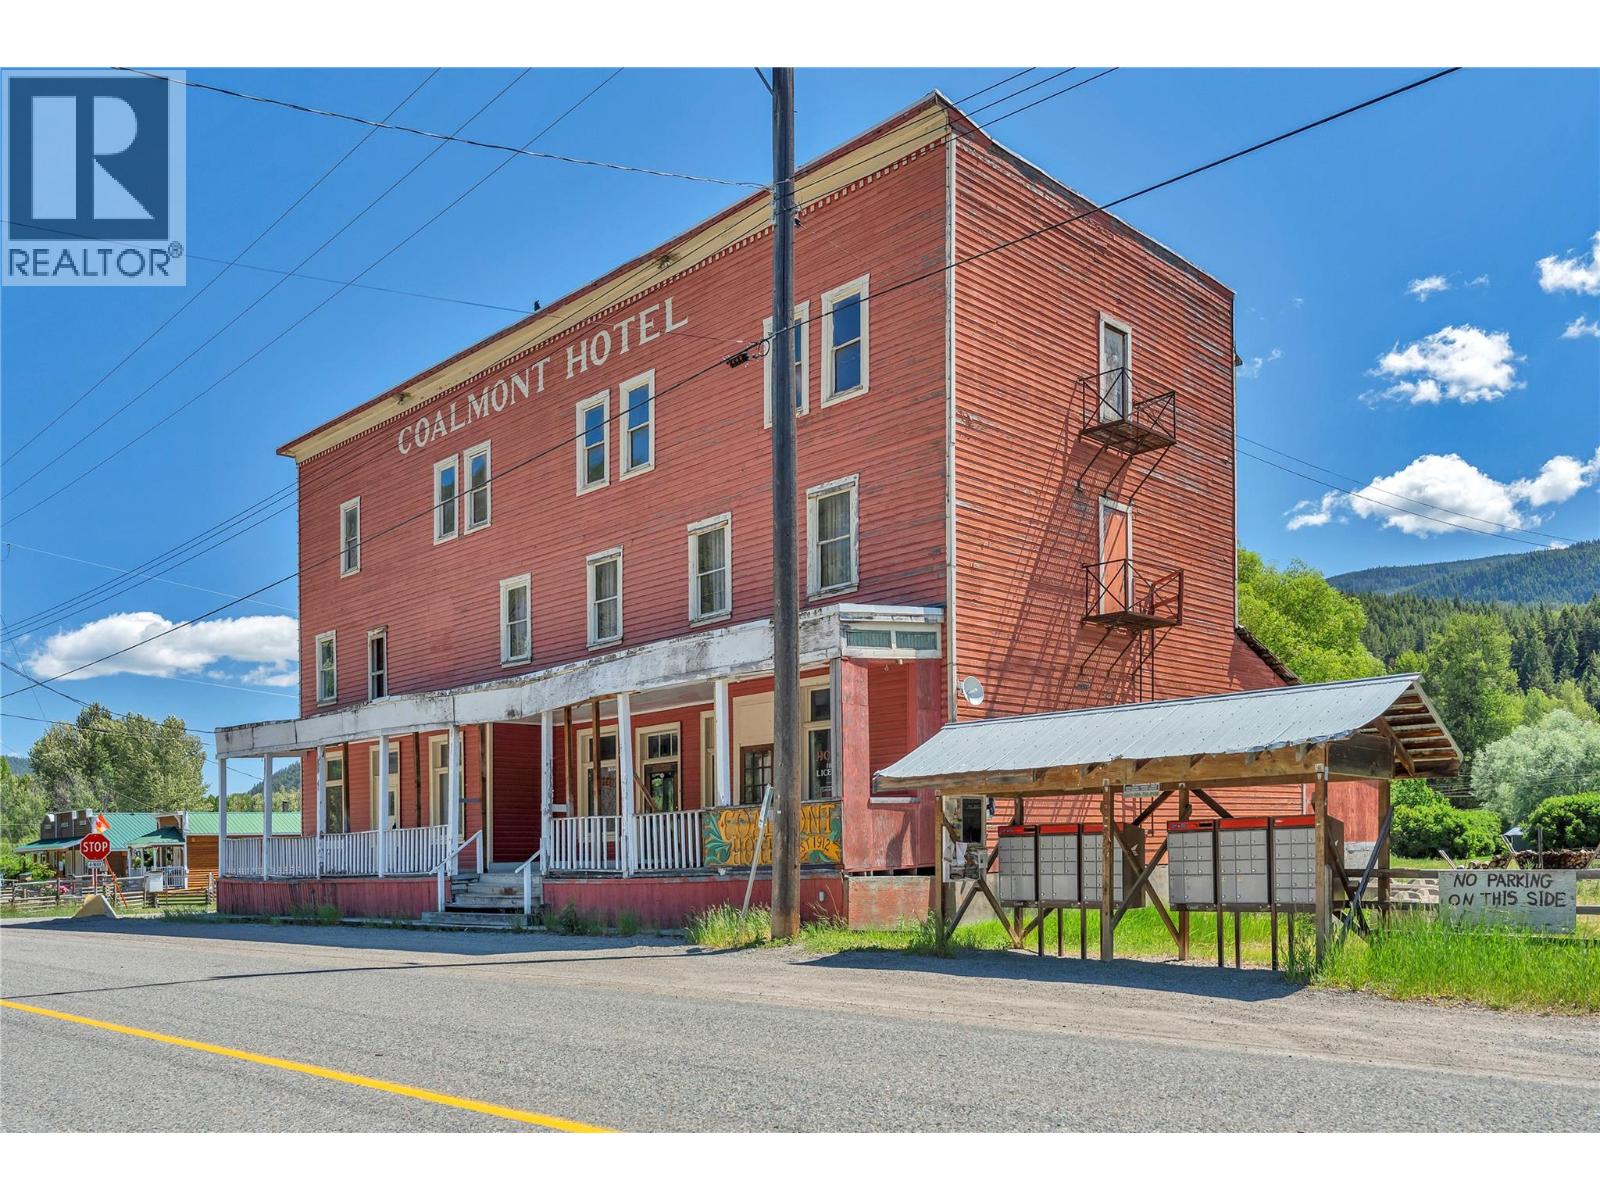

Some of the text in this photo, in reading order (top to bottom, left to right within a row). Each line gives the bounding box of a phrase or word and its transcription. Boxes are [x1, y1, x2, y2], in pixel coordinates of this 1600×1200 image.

[397, 296, 689, 455] COALMONT HOTEL
[816, 768, 832, 777] LICE
[718, 803, 836, 842] COALNT
[83, 841, 108, 853] STOP
[1453, 873, 1553, 888] NO PARKING
[1448, 890, 1566, 907] ON THIS SIDE
